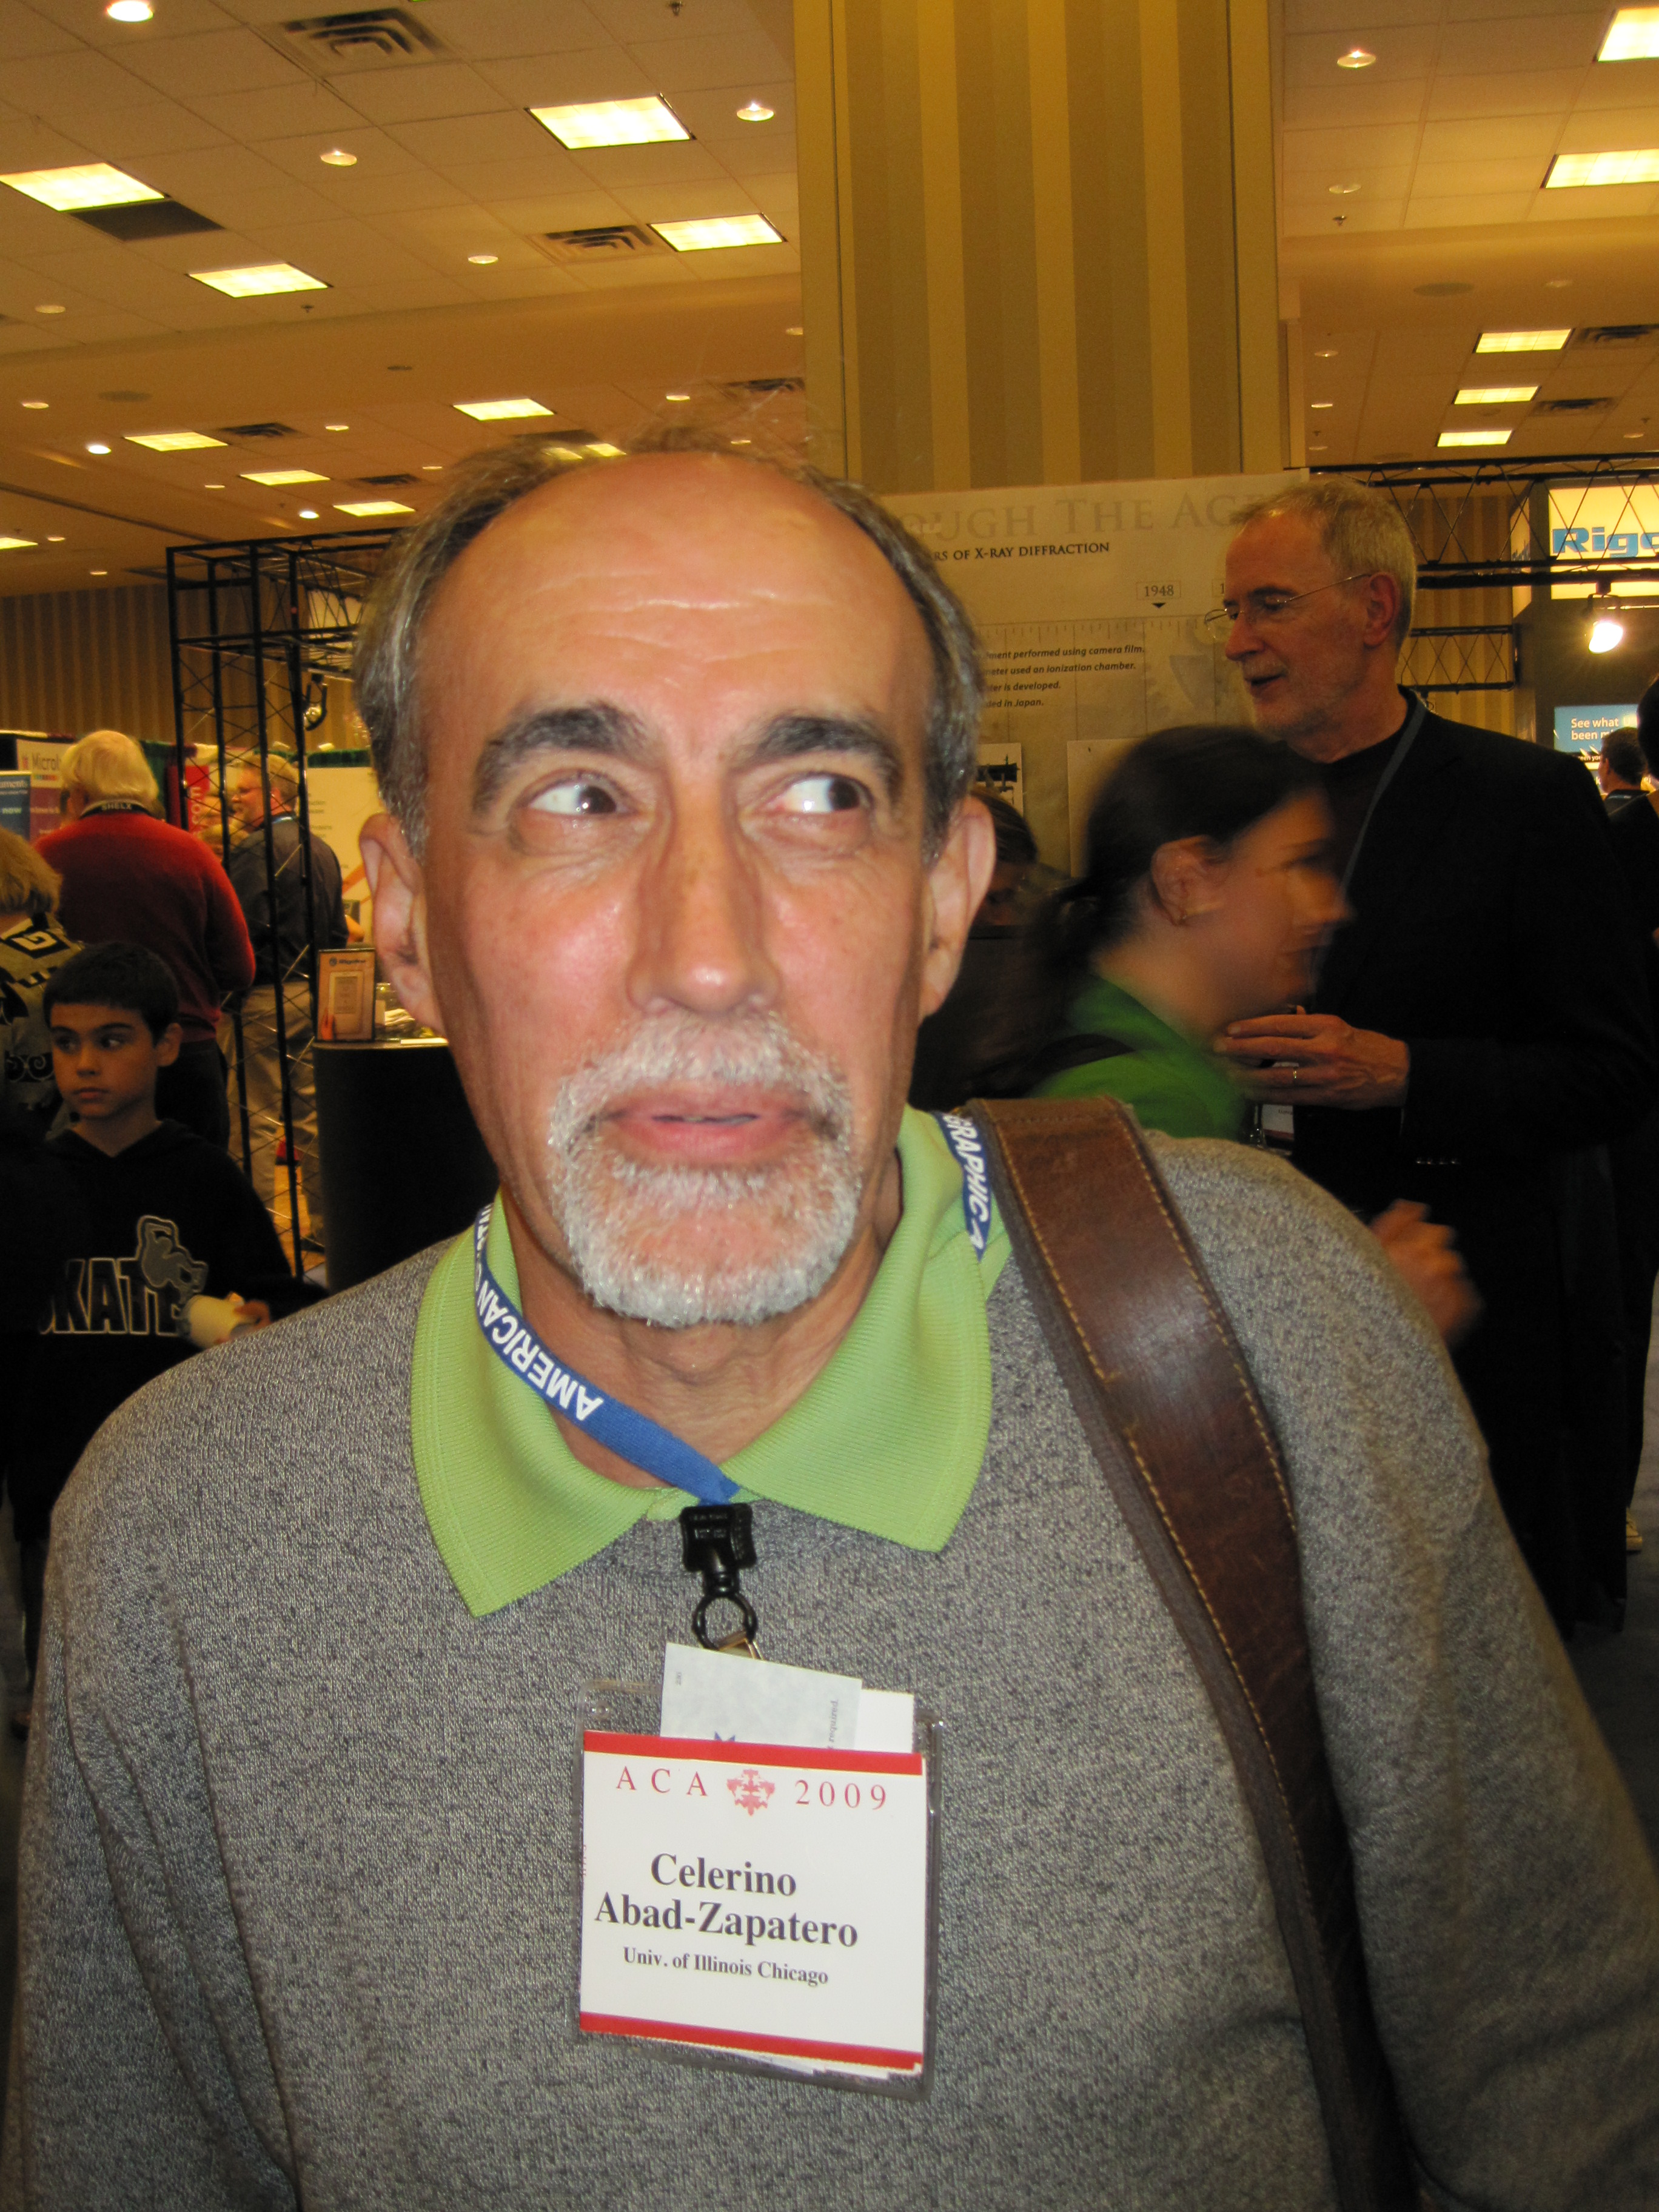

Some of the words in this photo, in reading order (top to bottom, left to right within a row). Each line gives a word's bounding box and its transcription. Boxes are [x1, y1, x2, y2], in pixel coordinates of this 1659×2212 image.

[902, 504, 1038, 541] OUGH
[1054, 497, 1154, 534] THE
[953, 549, 970, 561] OF
[974, 546, 1016, 560] X-RAY
[1019, 542, 1110, 557] DIFFRACTION
[1144, 585, 1174, 597] 1948
[1013, 648, 1061, 660] performed
[1063, 647, 1087, 657] using
[1089, 646, 1122, 655] camera
[1124, 645, 1145, 654] film.
[1047, 665, 1092, 674] ionization
[1094, 662, 1136, 671] chamber.
[1004, 682, 1011, 691] is
[1013, 680, 1061, 692] developed.
[1014, 699, 1044, 709] Japan.
[1571, 717, 1590, 728] See
[1592, 717, 1619, 728] what
[1571, 730, 1598, 740] been
[476, 1279, 603, 1421] AMERICAN
[794, 1778, 886, 1811] 2009
[651, 1852, 797, 1897] Celerino
[594, 1891, 859, 1948] Abad-Zapatero
[623, 1945, 668, 1968] Univ.
[672, 1952, 690, 1970] of
[694, 1953, 752, 1977] Illinois
[757, 1960, 830, 1988] Chicago
